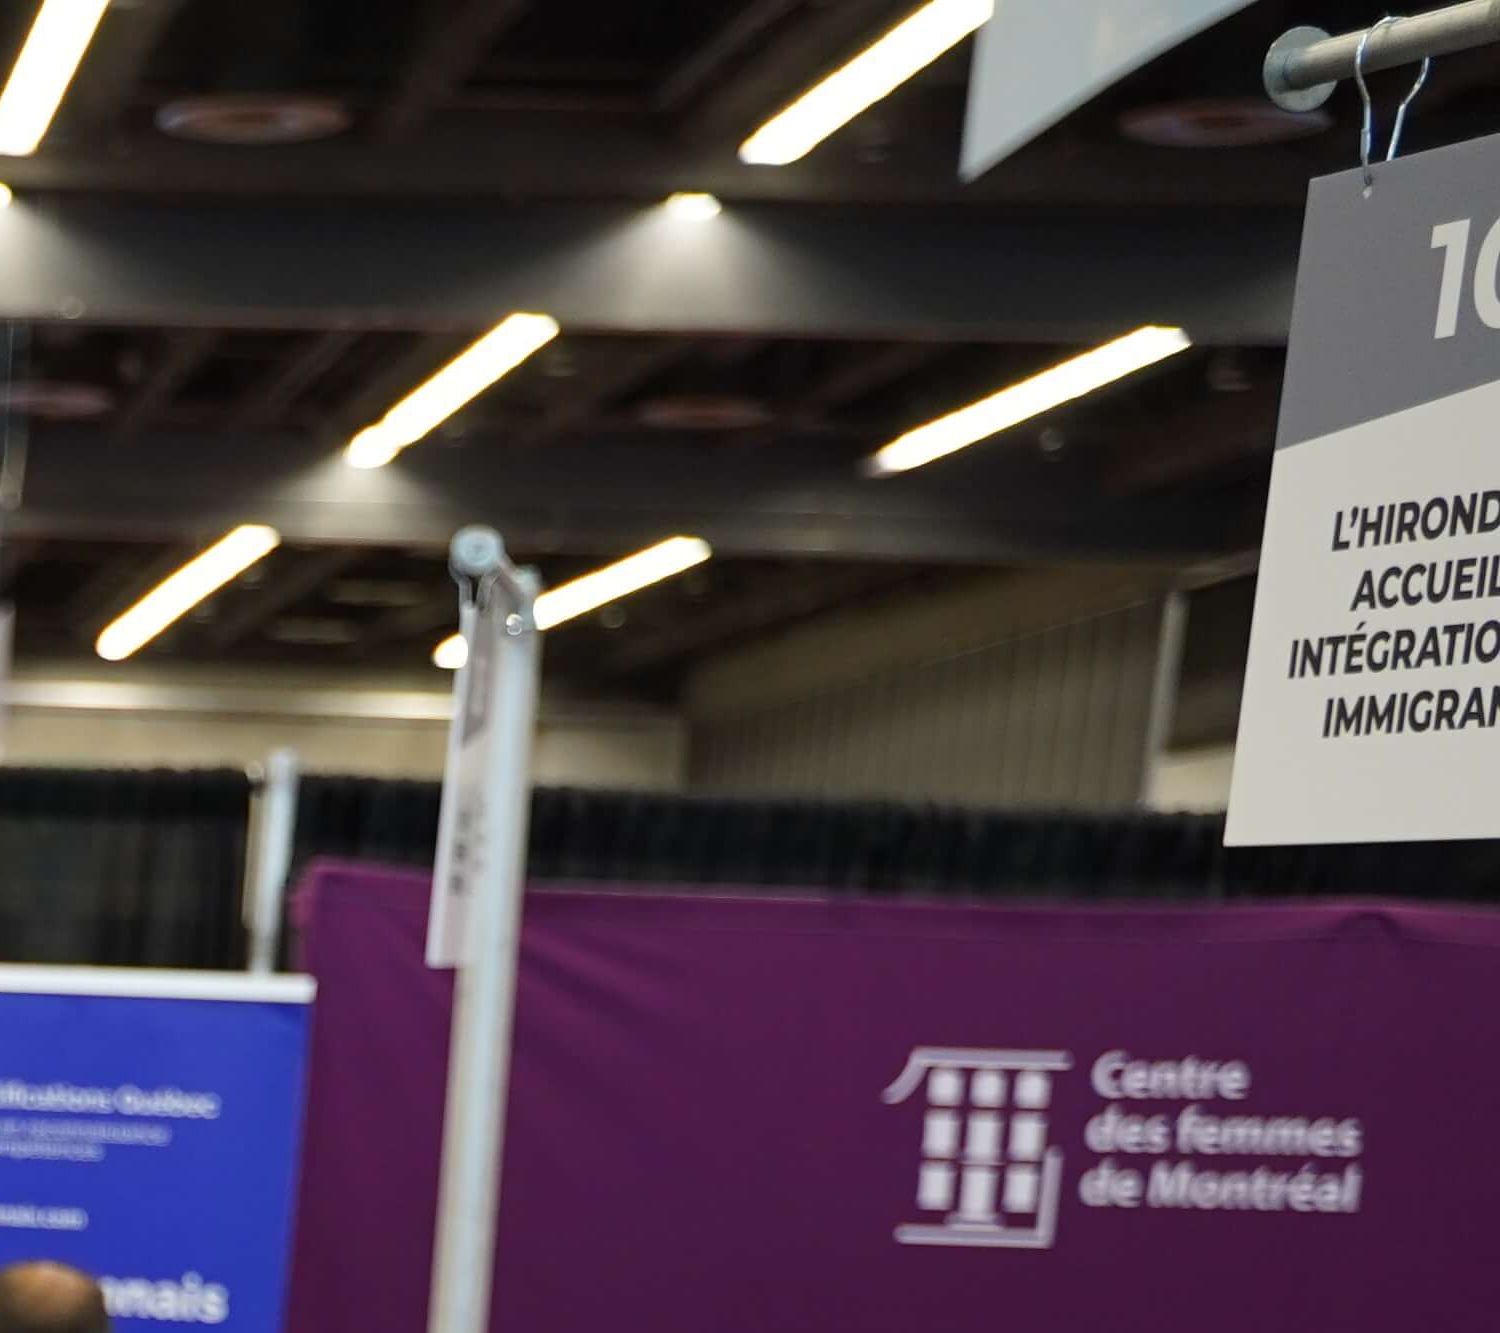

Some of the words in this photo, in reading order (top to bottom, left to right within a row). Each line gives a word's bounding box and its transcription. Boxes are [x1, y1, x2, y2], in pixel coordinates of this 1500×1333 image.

[1090, 1049, 1252, 1100] Centre
[1084, 1103, 1171, 1154] des
[1176, 1103, 1363, 1157] femmes
[1079, 1158, 1144, 1208] de
[1147, 1159, 1363, 1213] Montréal
